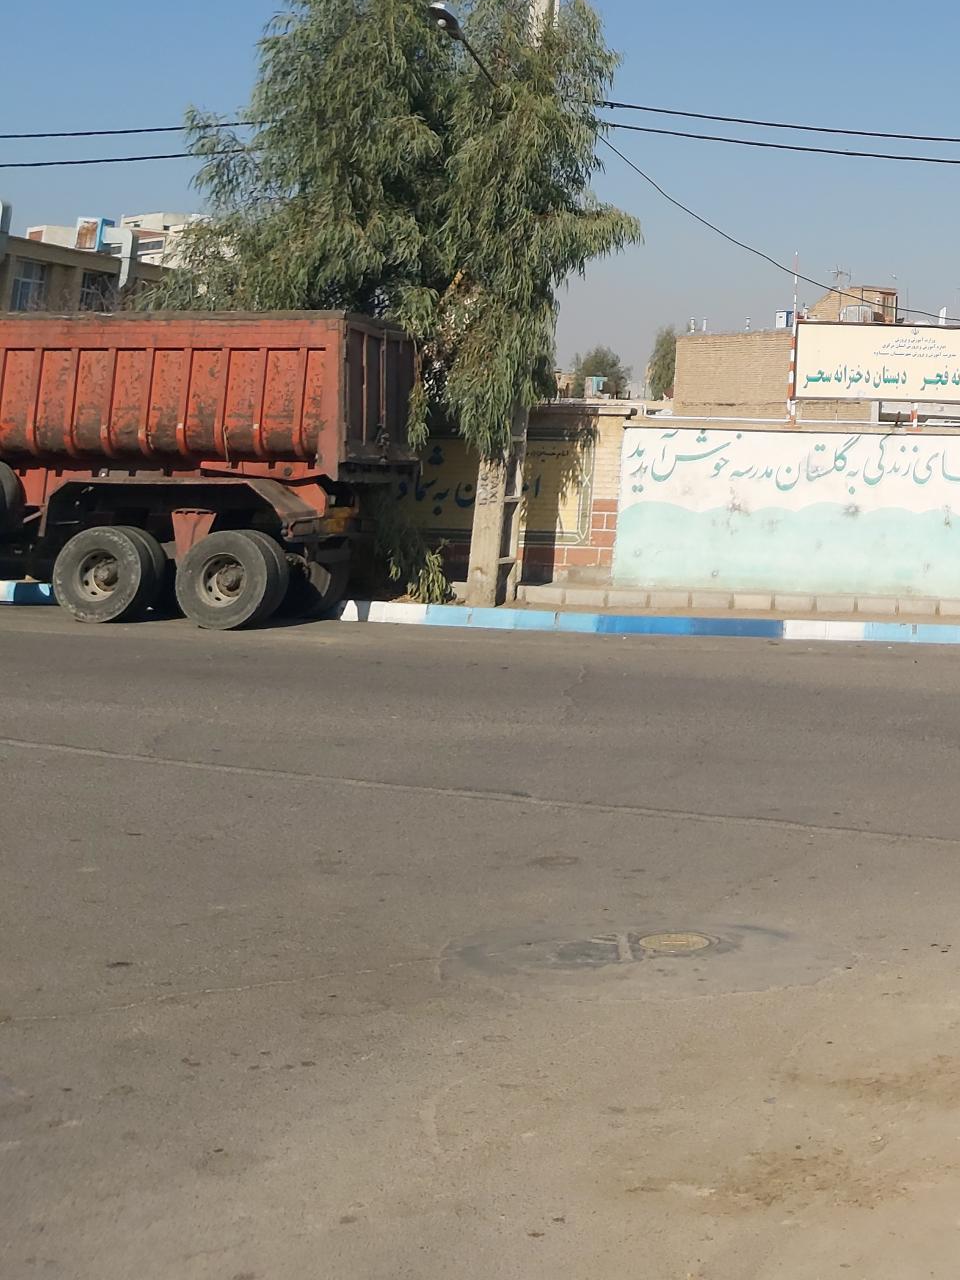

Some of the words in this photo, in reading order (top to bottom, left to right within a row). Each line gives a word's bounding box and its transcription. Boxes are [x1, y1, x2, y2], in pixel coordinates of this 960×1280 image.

[802, 369, 832, 389] سحر
[833, 364, 871, 390] دخترانه
[872, 365, 907, 390] دبستان
[919, 364, 949, 391] فجر
[650, 429, 743, 483] خوش
[775, 435, 861, 491] گلستان
[863, 434, 918, 486] زندگی
[730, 465, 773, 479] مدرسه
[846, 466, 860, 495] به
